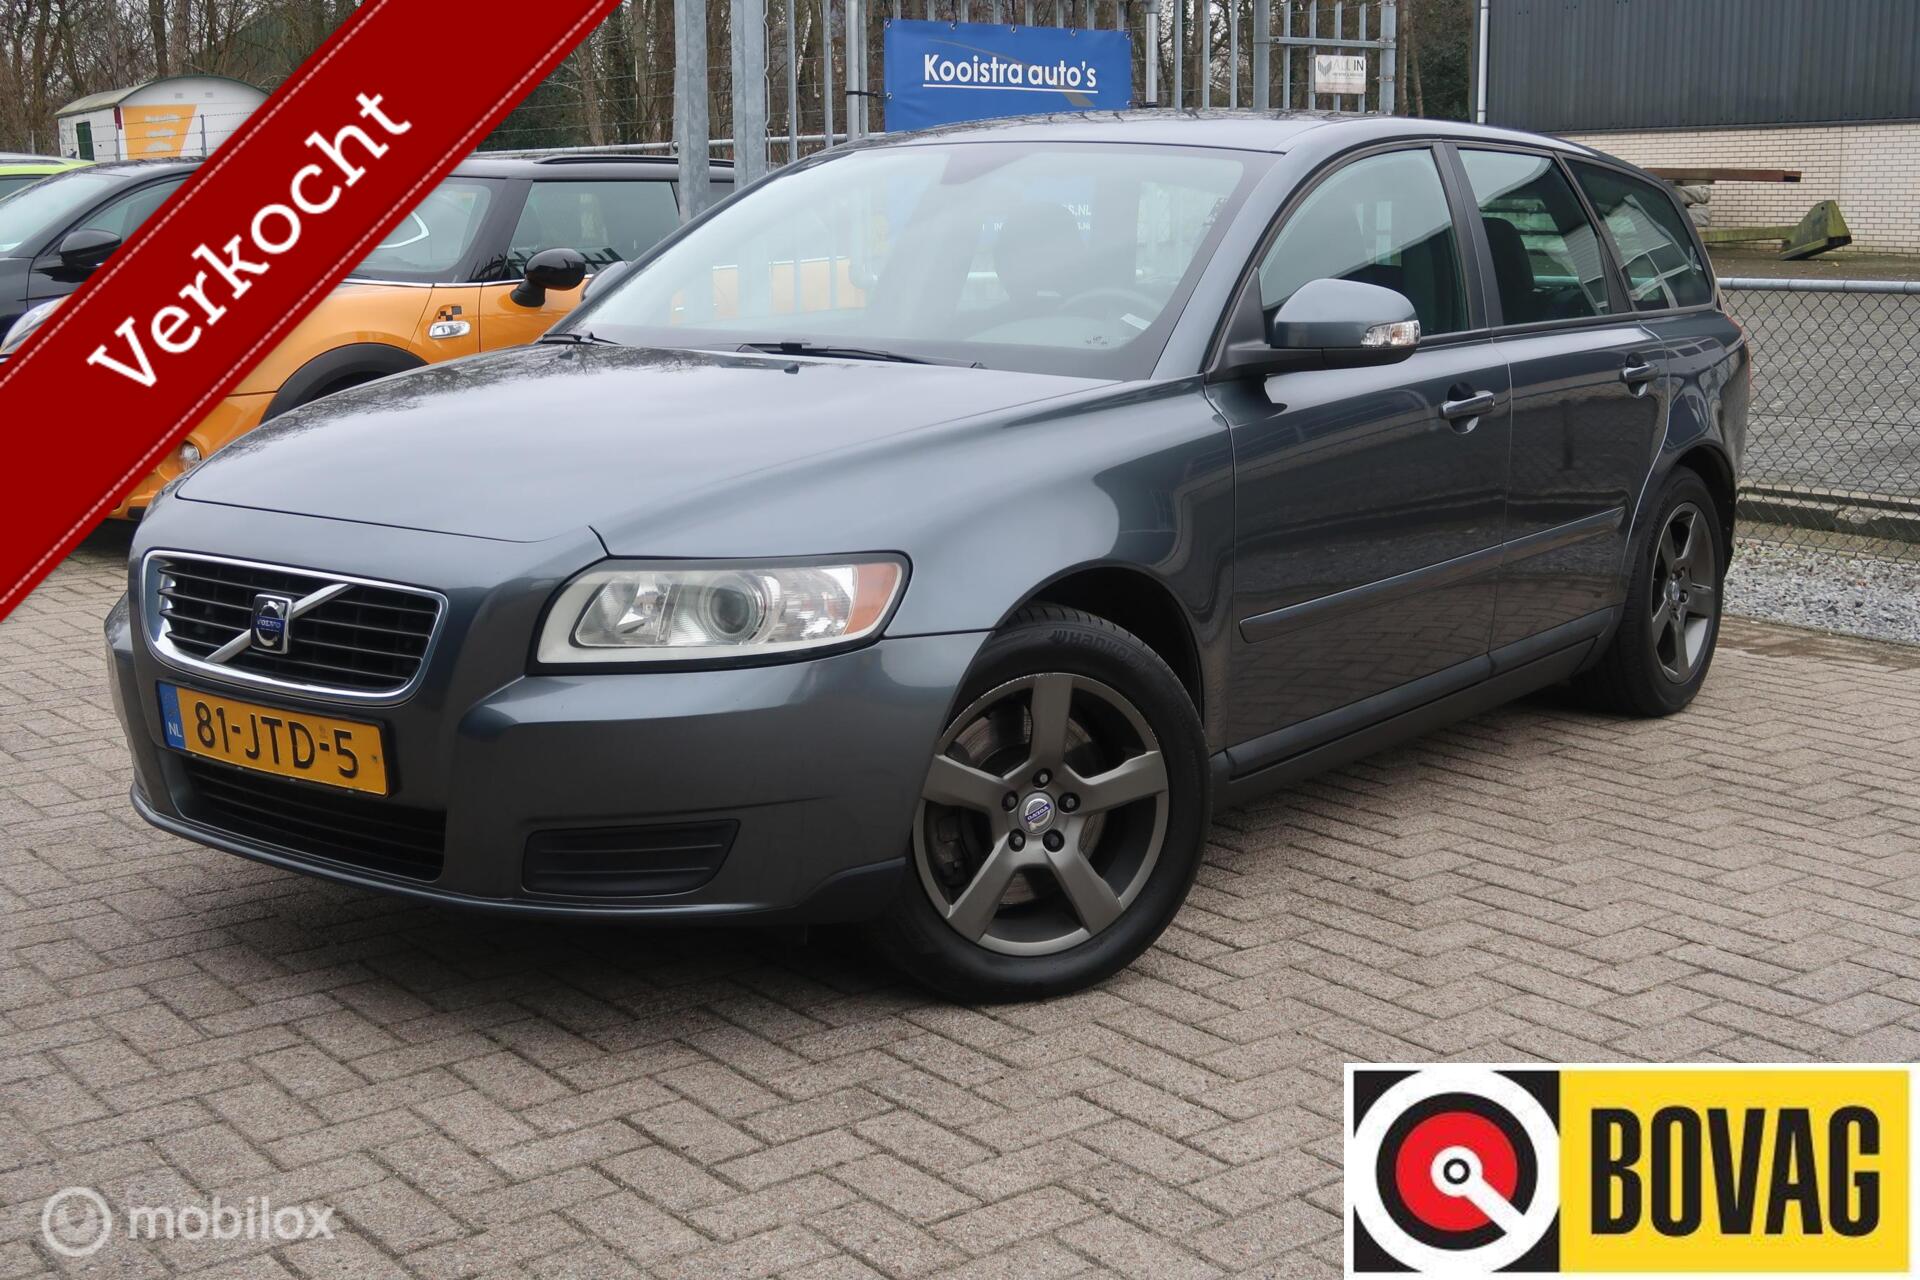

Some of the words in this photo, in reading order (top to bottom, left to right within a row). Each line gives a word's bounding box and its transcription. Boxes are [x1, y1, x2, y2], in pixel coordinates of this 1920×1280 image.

[924, 54, 1023, 84] Kooistra
[1027, 60, 1097, 88] auto's
[1353, 59, 1364, 71] IN
[168, 721, 183, 738] NL
[194, 701, 359, 780] 81-JTD-5
